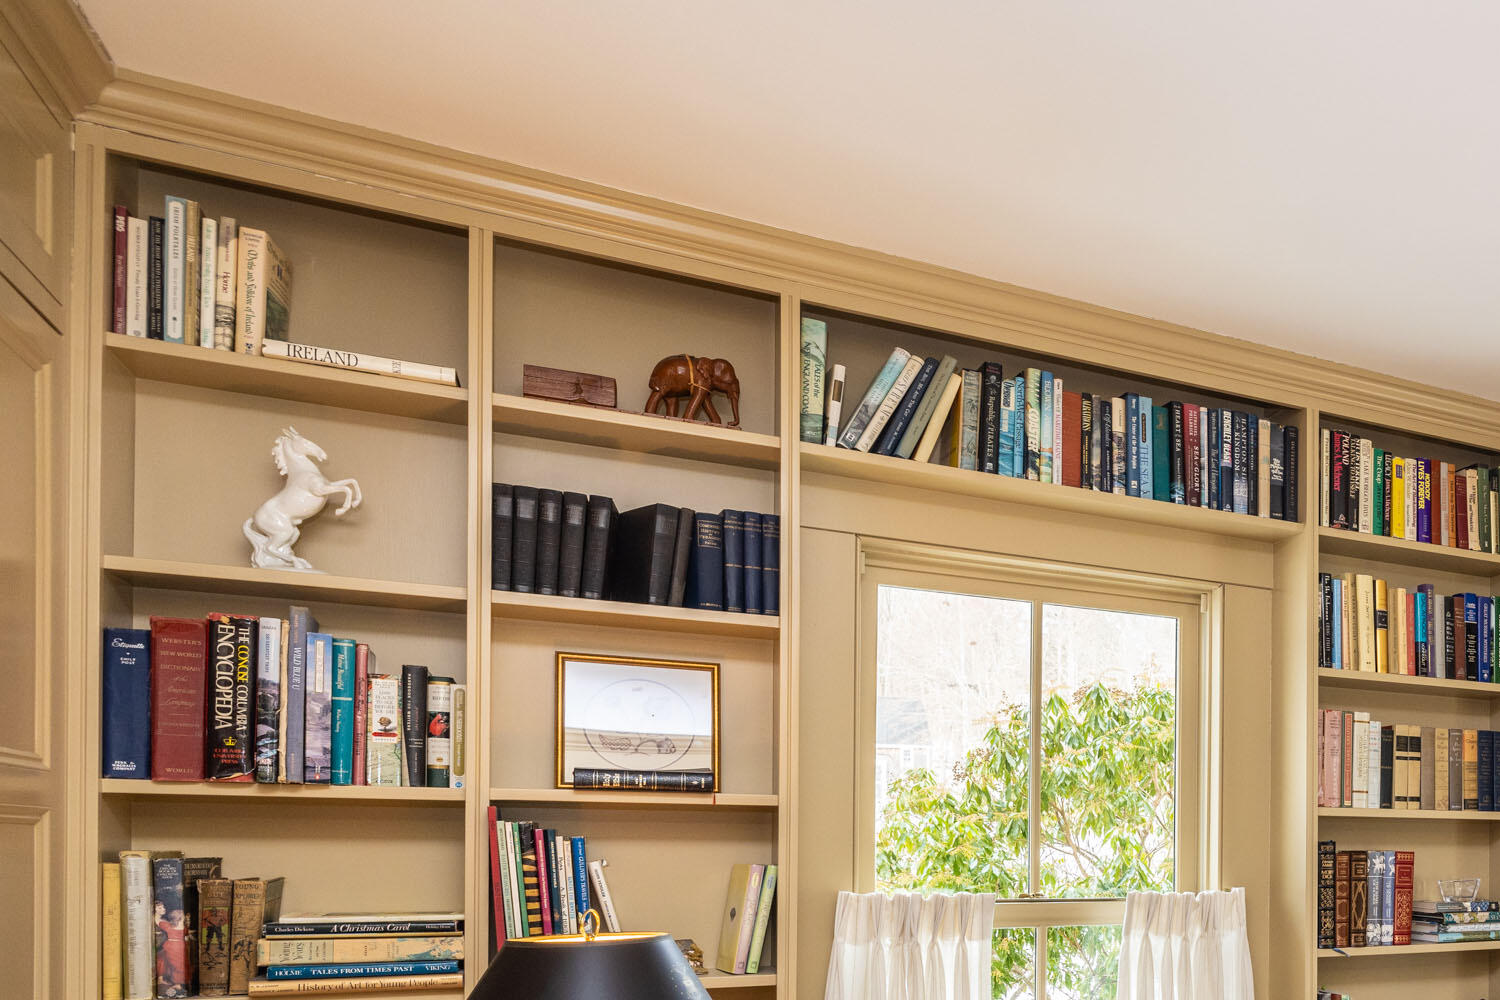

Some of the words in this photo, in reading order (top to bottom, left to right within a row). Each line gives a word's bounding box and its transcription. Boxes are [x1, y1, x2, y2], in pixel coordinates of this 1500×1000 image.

[222, 271, 231, 294] Home
[247, 271, 256, 282] and
[245, 313, 255, 334] Ireland
[286, 343, 359, 368] IRELAND
[802, 360, 811, 394] ENGLAND
[985, 396, 995, 422] Republic
[1015, 422, 1024, 449] Passage
[1223, 410, 1232, 442] BENCHLEY
[987, 427, 995, 458] PIRATES
[1334, 431, 1342, 455] James
[1342, 434, 1350, 465] POLAND
[1140, 444, 1149, 466] THE
[1384, 454, 1392, 477] LEGACY
[1140, 468, 1149, 487] SEA
[1334, 461, 1342, 492] Michener
[111, 638, 145, 650] Etiquette
[161, 637, 202, 645] WEBSTER'S
[239, 627, 250, 645] THE
[237, 644, 249, 683] CONCISE
[292, 647, 302, 665] WILD
[337, 653, 345, 668] Maine
[215, 624, 236, 731] ENCYCLOPEDIA
[292, 666, 302, 683] BLUE
[337, 669, 345, 690] Beautiful
[236, 684, 249, 731] COLUMBIA
[578, 856, 586, 882] GULLIVER'S
[330, 923, 338, 933] A
[340, 923, 385, 933] Christmas
[386, 922, 411, 931] Carol
[275, 969, 303, 977] HOLME
[340, 967, 364, 975] FROM
[365, 966, 391, 974] TIMES
[393, 965, 415, 973] PAST
[297, 983, 334, 993] History
[348, 981, 362, 990] Art
[377, 980, 406, 991] Young
